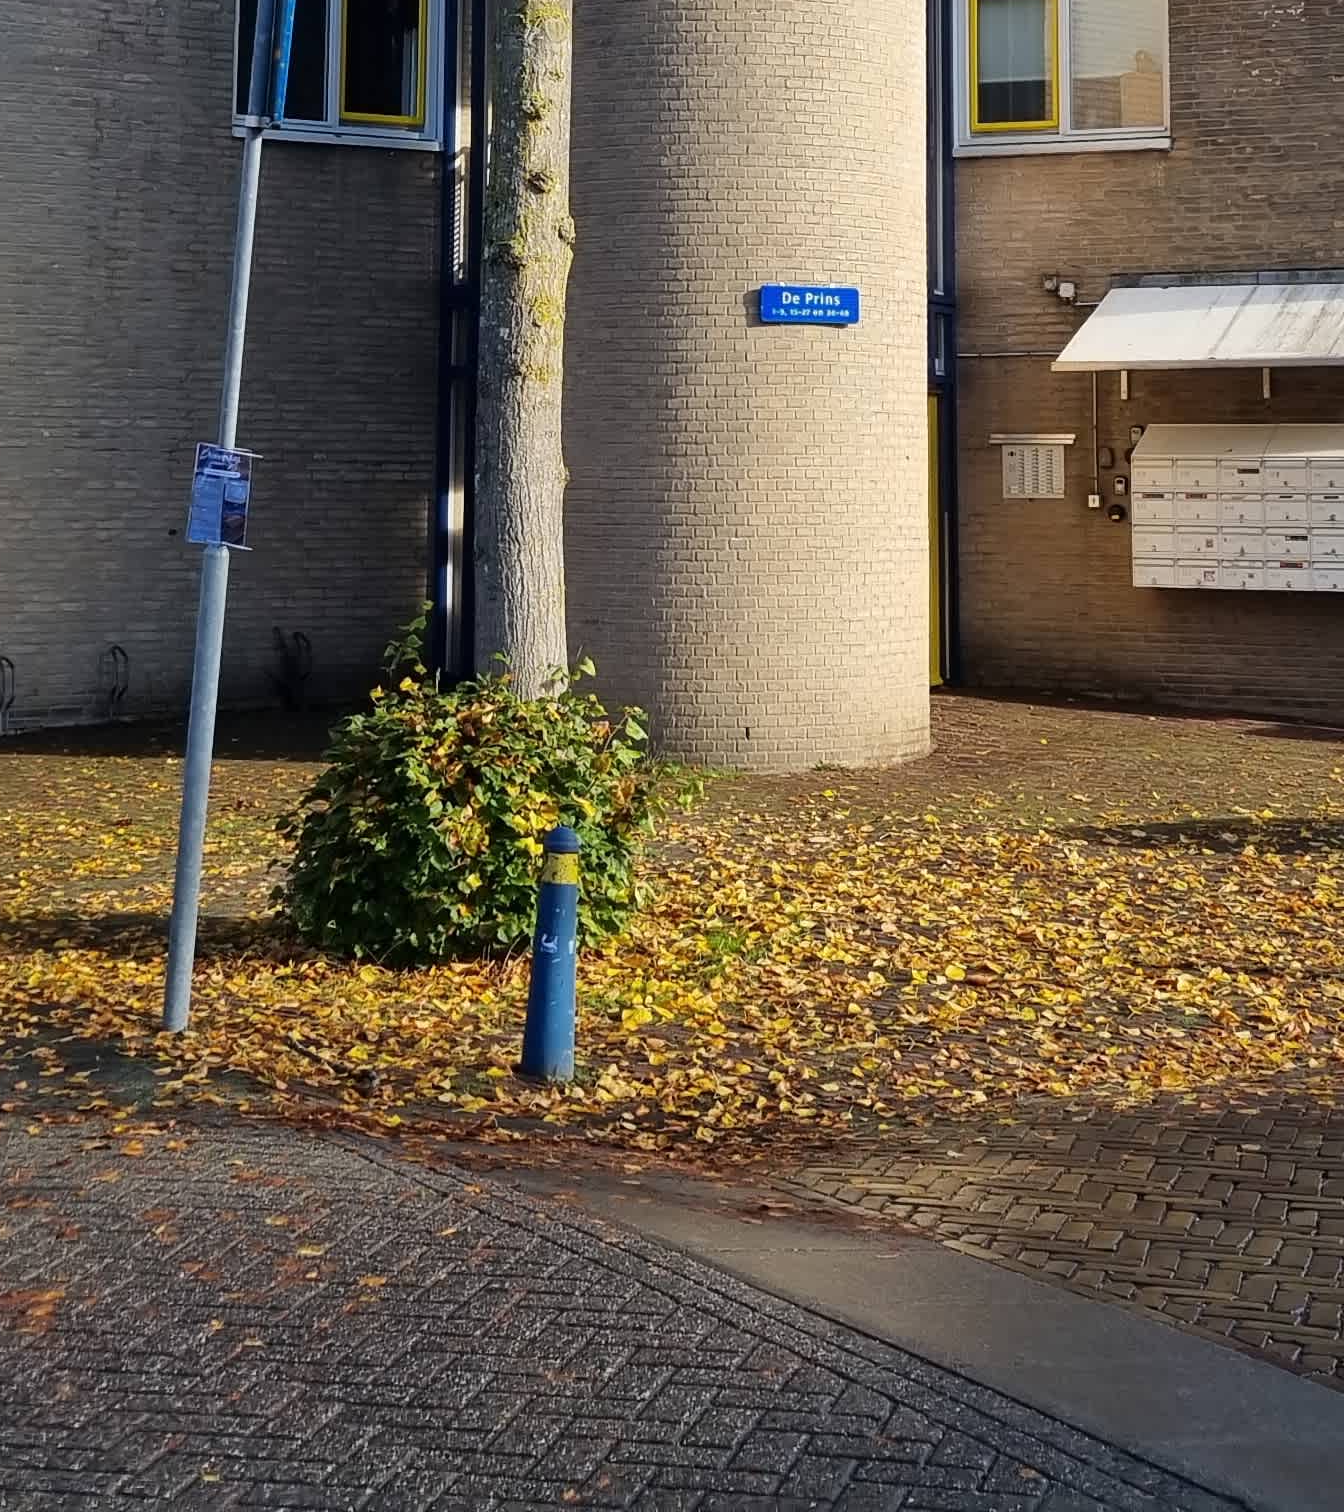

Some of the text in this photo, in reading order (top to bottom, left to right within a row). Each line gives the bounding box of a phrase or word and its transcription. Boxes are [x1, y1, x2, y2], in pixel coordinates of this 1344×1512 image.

[782, 291, 841, 306] De Prins
[813, 309, 823, 317] en
